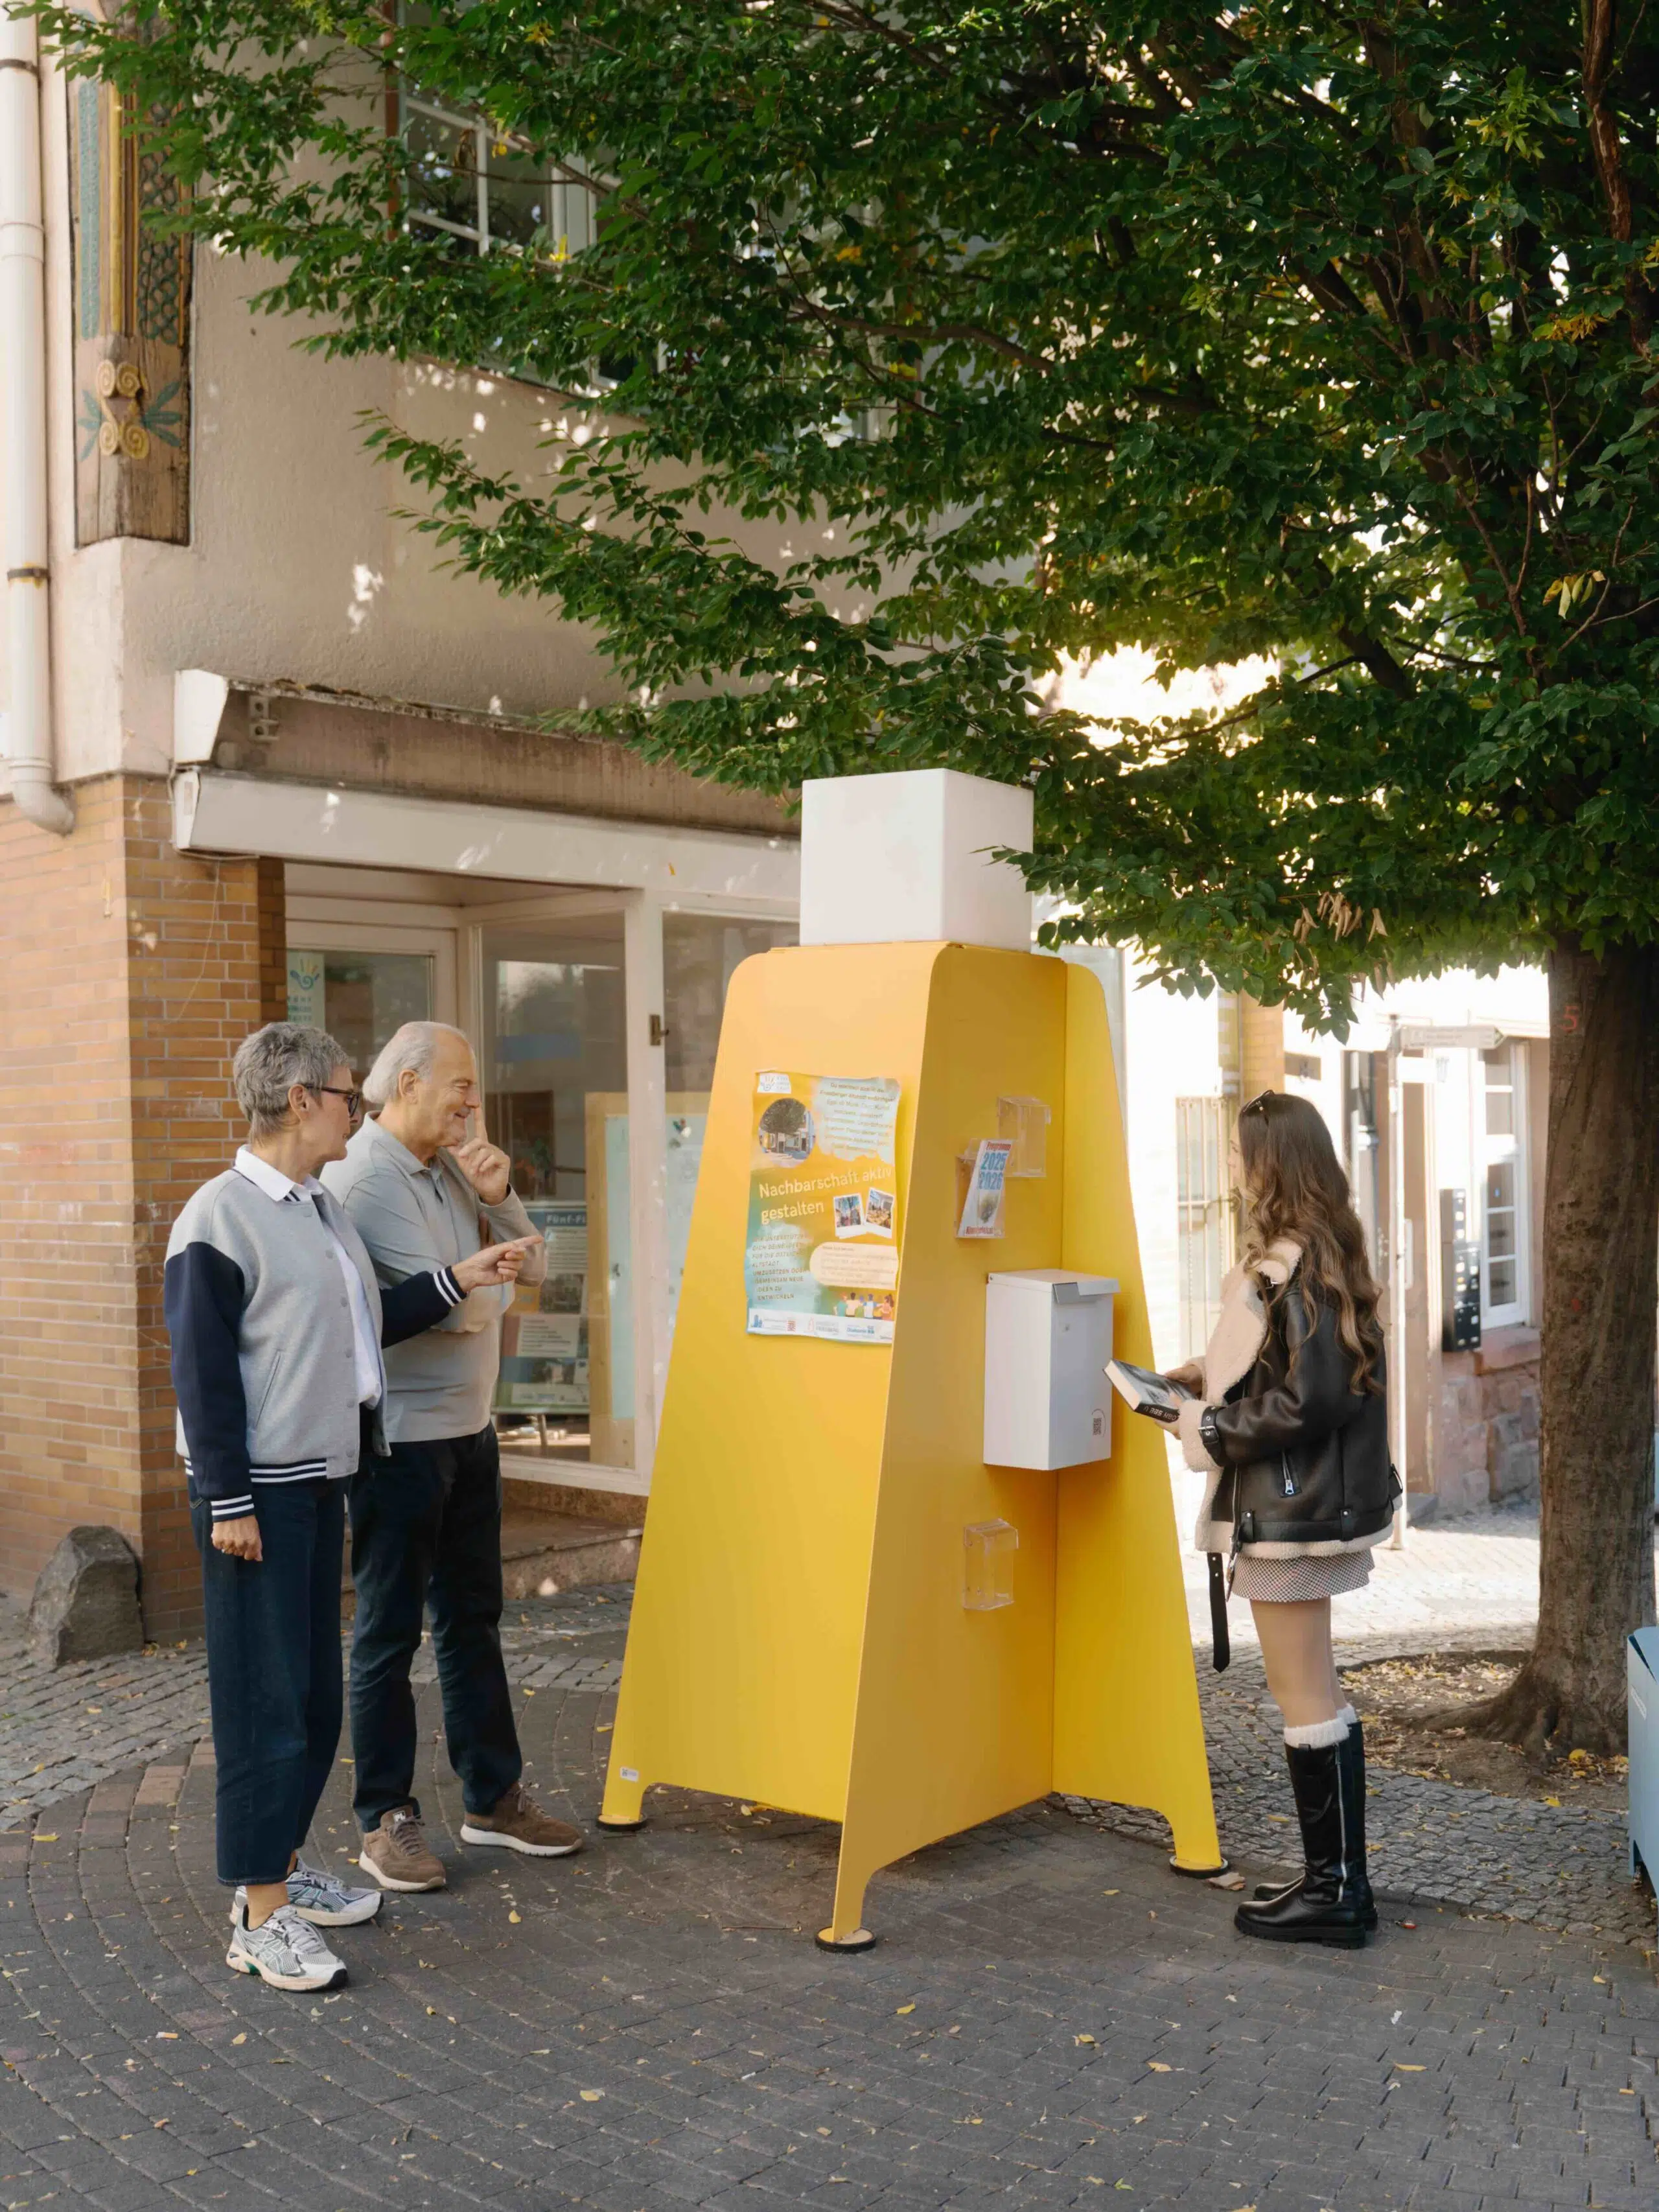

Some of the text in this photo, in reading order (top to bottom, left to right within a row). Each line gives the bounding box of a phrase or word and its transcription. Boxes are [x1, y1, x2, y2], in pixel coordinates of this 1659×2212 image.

[986, 1142, 1012, 1151] Programm
[980, 1152, 1008, 1171] 2025
[759, 1166, 892, 1198] Nachbarschaft aktiv
[978, 1171, 1003, 1190] 2026
[761, 1202, 824, 1225] gestalten
